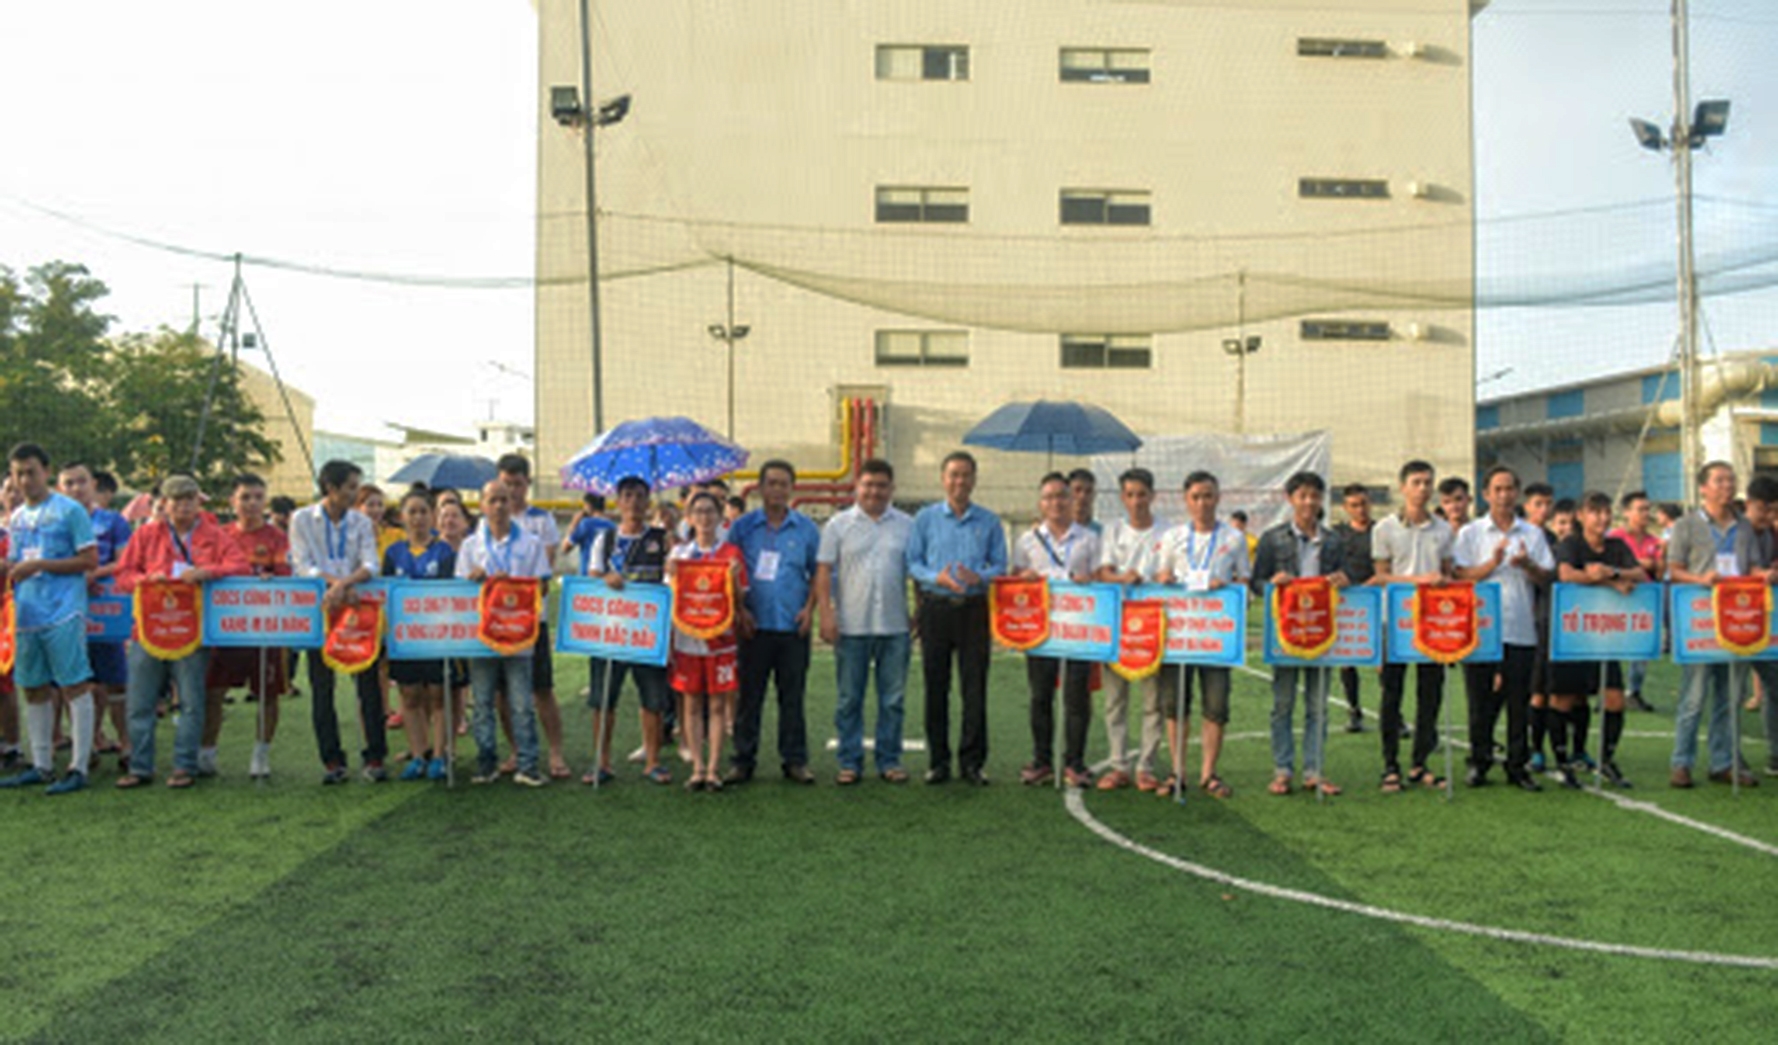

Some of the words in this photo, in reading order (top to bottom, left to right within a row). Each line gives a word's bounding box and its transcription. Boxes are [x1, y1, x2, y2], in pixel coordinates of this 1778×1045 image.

[607, 597, 639, 619] CÔNG
[644, 602, 658, 620] TY
[1582, 612, 1627, 635] TRỌNG
